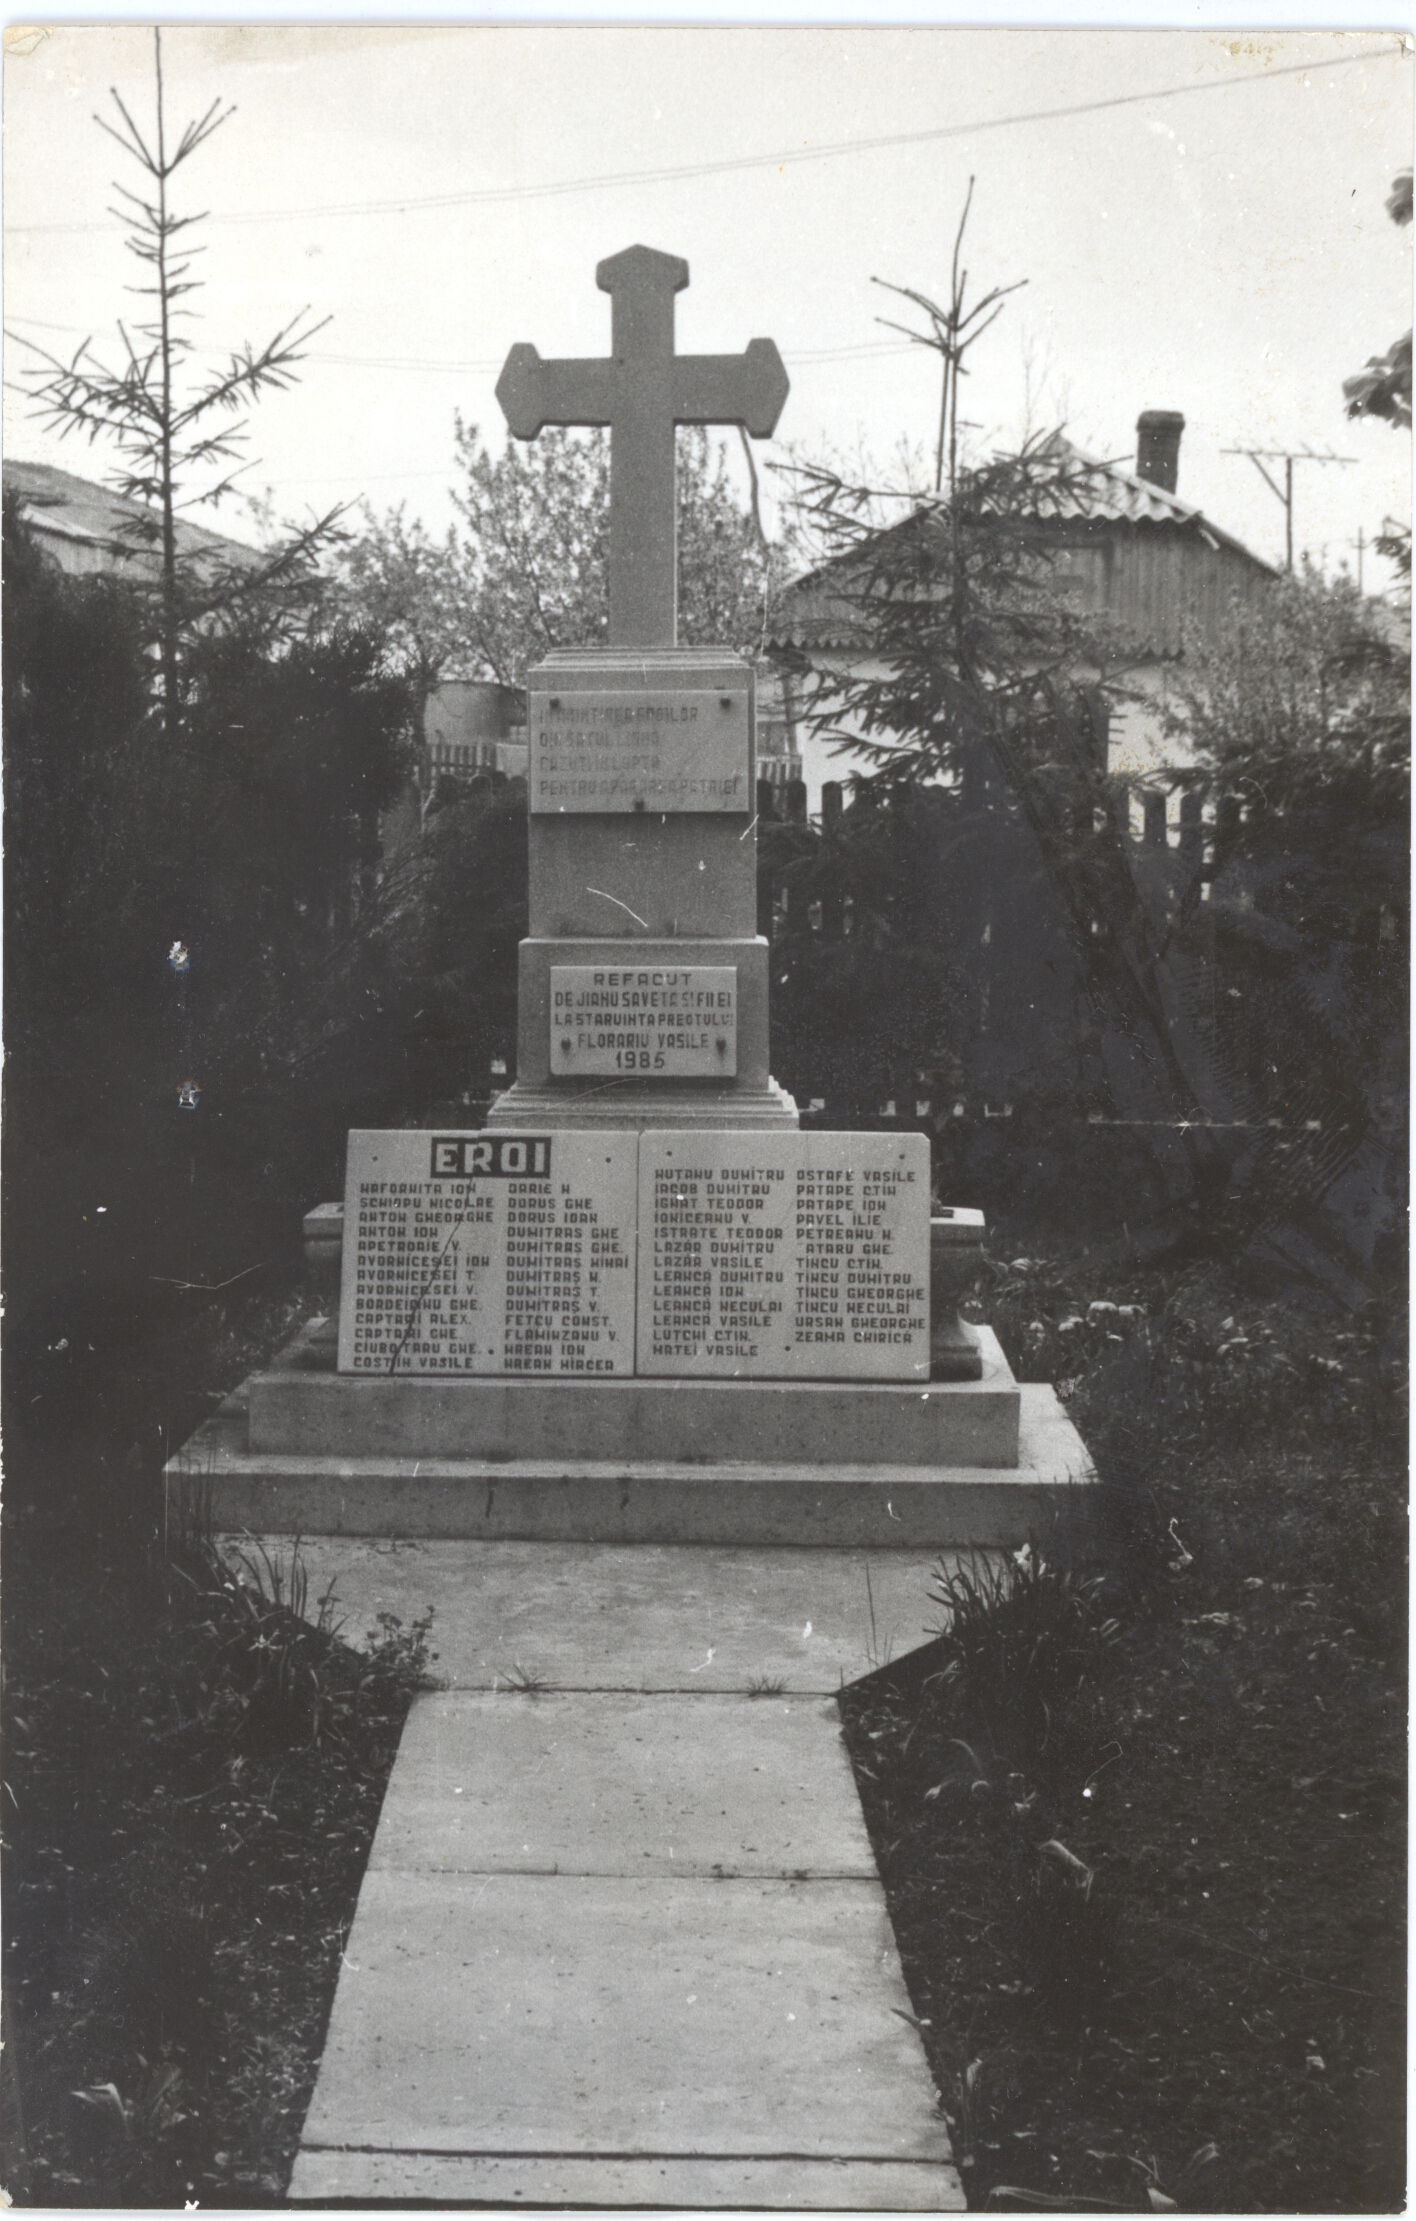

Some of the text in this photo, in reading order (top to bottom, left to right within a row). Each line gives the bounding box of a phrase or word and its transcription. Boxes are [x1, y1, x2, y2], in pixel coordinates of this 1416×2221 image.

[594, 973, 691, 986] REFACUT
[555, 992, 572, 1007] DE
[555, 1014, 572, 1026] LA
[578, 1033, 708, 1049] FLORARIU VASILE
[616, 1051, 665, 1069] 1985
[436, 1142, 545, 1173] EROI
[722, 1168, 784, 1180] DUMITRU
[797, 1170, 915, 1182] OSTAFE VASILE
[451, 1184, 476, 1193] ION
[655, 1183, 770, 1194] IACOB DUMITRU
[655, 1198, 764, 1209] IGNAT TEODOR
[863, 1198, 886, 1210] ION
[359, 1212, 494, 1222] ANTON GHEORGHE
[796, 1212, 881, 1225] PAVEL ILIE
[359, 1227, 438, 1237] ANTON ION
[655, 1228, 783, 1238] ISTRATE TEODOR
[711, 1241, 774, 1253] DUMITRU
[796, 1242, 854, 1254] ATARU
[467, 1256, 490, 1266] ION
[711, 1256, 763, 1268] VASILE
[796, 1258, 838, 1268] TINCU
[720, 1272, 783, 1282] DUMITRU
[796, 1272, 911, 1284] TINCU DUMITRU
[720, 1286, 744, 1296] ION
[796, 1287, 925, 1300] TINCU GHEORGHE
[796, 1302, 838, 1313] TINCU
[720, 1316, 772, 1326] VASILE
[851, 1318, 926, 1329] GHEORGHE
[561, 1345, 585, 1355] ION
[706, 1345, 758, 1356] VASILE
[420, 1358, 473, 1368] VASILE
